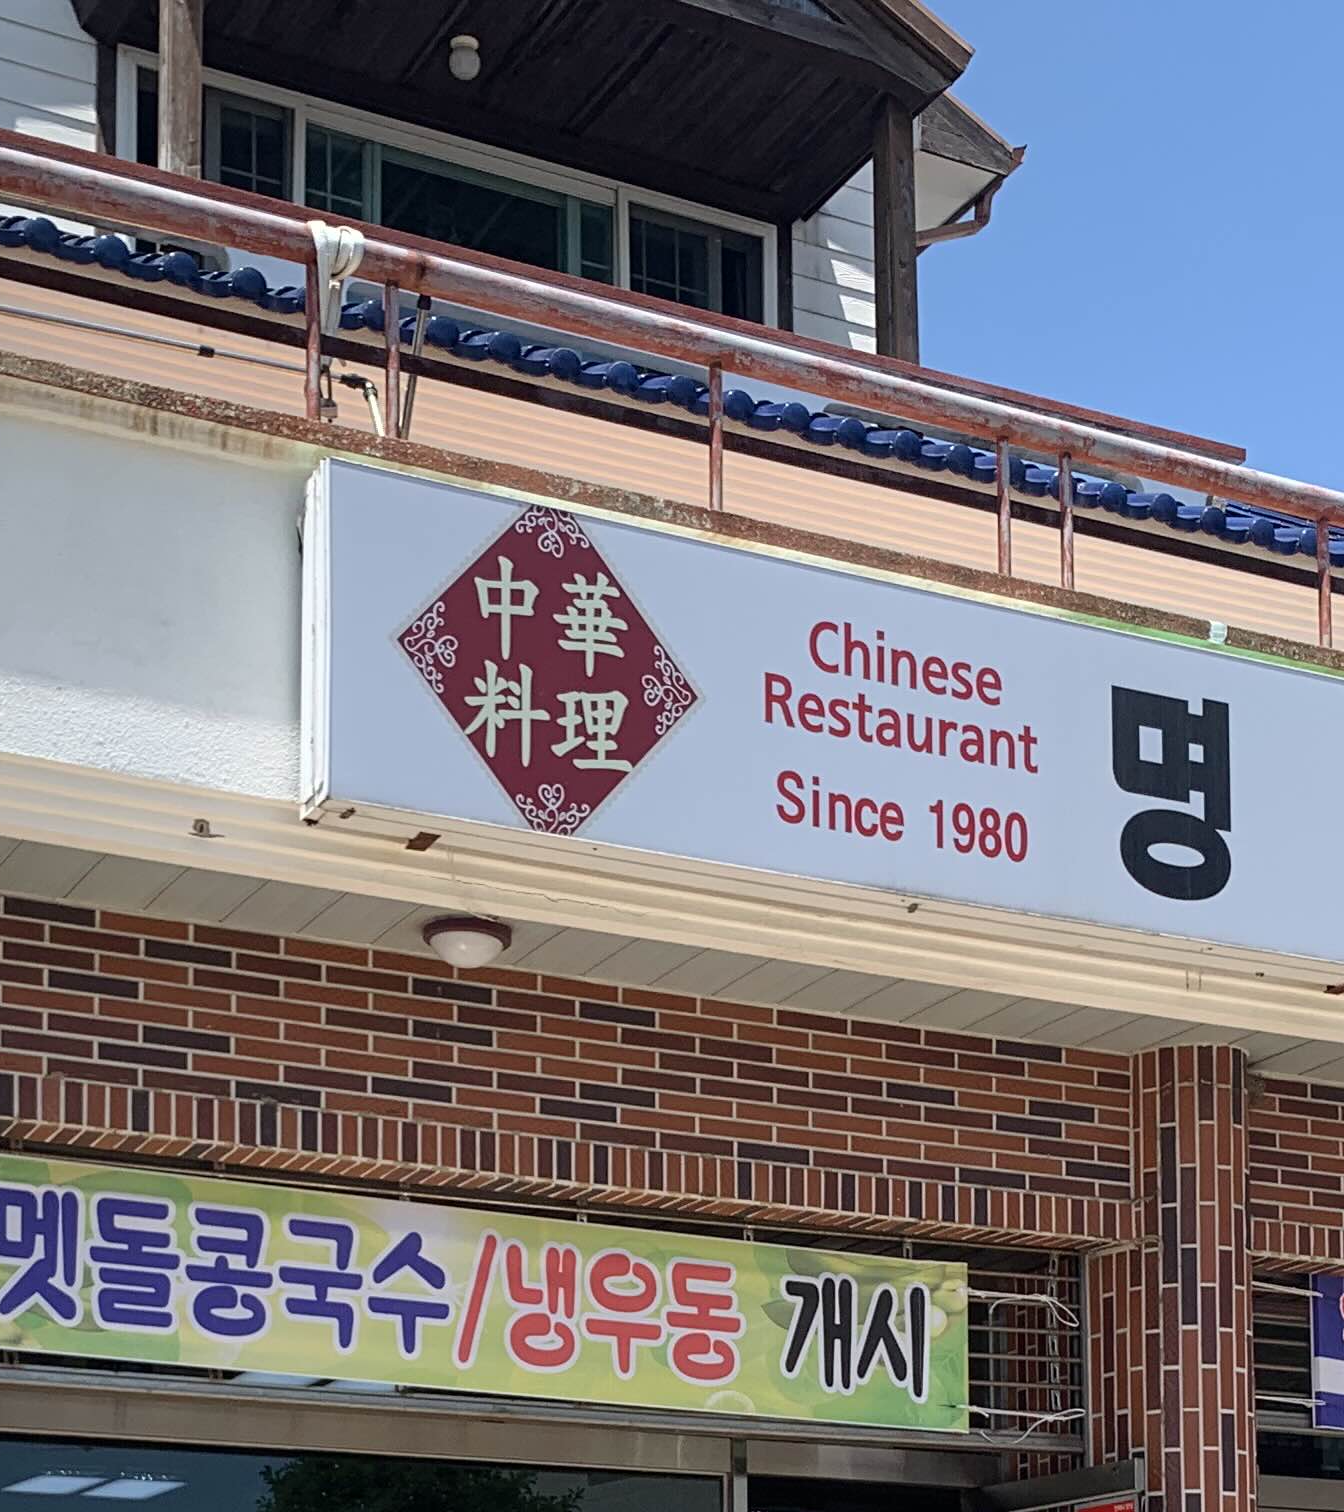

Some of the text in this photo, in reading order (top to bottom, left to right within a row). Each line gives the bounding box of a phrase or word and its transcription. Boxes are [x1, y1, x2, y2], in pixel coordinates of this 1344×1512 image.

[474, 556, 627, 676] 中華
[808, 620, 1003, 706] Chinese
[464, 659, 632, 771] 料理
[764, 672, 1038, 773] Restaurant
[777, 770, 1028, 863] Since 1980
[782, 1275, 929, 1402] 개시
